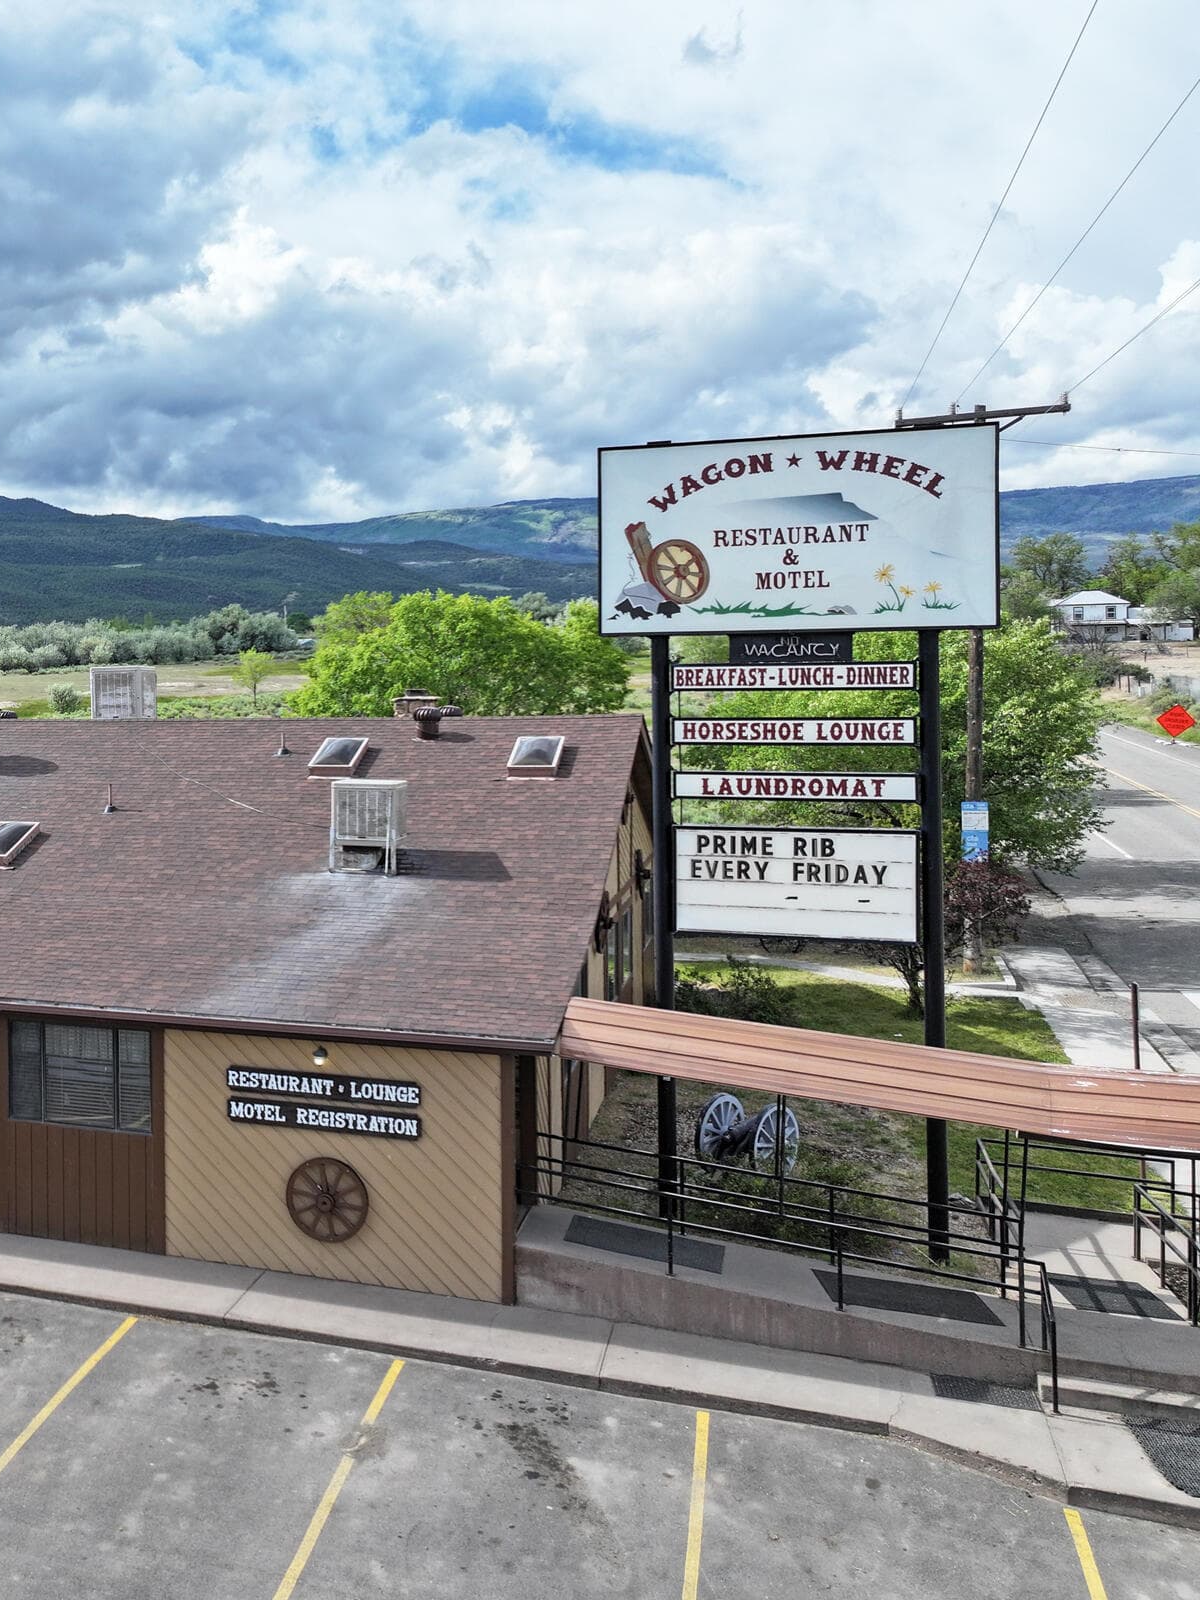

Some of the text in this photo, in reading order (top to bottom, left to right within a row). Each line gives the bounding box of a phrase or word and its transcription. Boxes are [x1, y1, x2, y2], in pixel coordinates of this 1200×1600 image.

[647, 450, 946, 513] WAGON WHEEL
[713, 523, 870, 548] RESTAURANT
[782, 549, 800, 566] &
[755, 570, 831, 591] MOTEL
[744, 643, 840, 657] VACANCY
[682, 722, 905, 742] HORSESHOE LOUNGE
[701, 778, 886, 798] LAUNDROMAT
[696, 834, 836, 858] PRIME RIB
[690, 859, 888, 886] EVERY FRIDAY
[228, 1070, 419, 1104] RESTAURANT LOUNGE
[230, 1101, 418, 1137] MOTEL REGISTRATION
